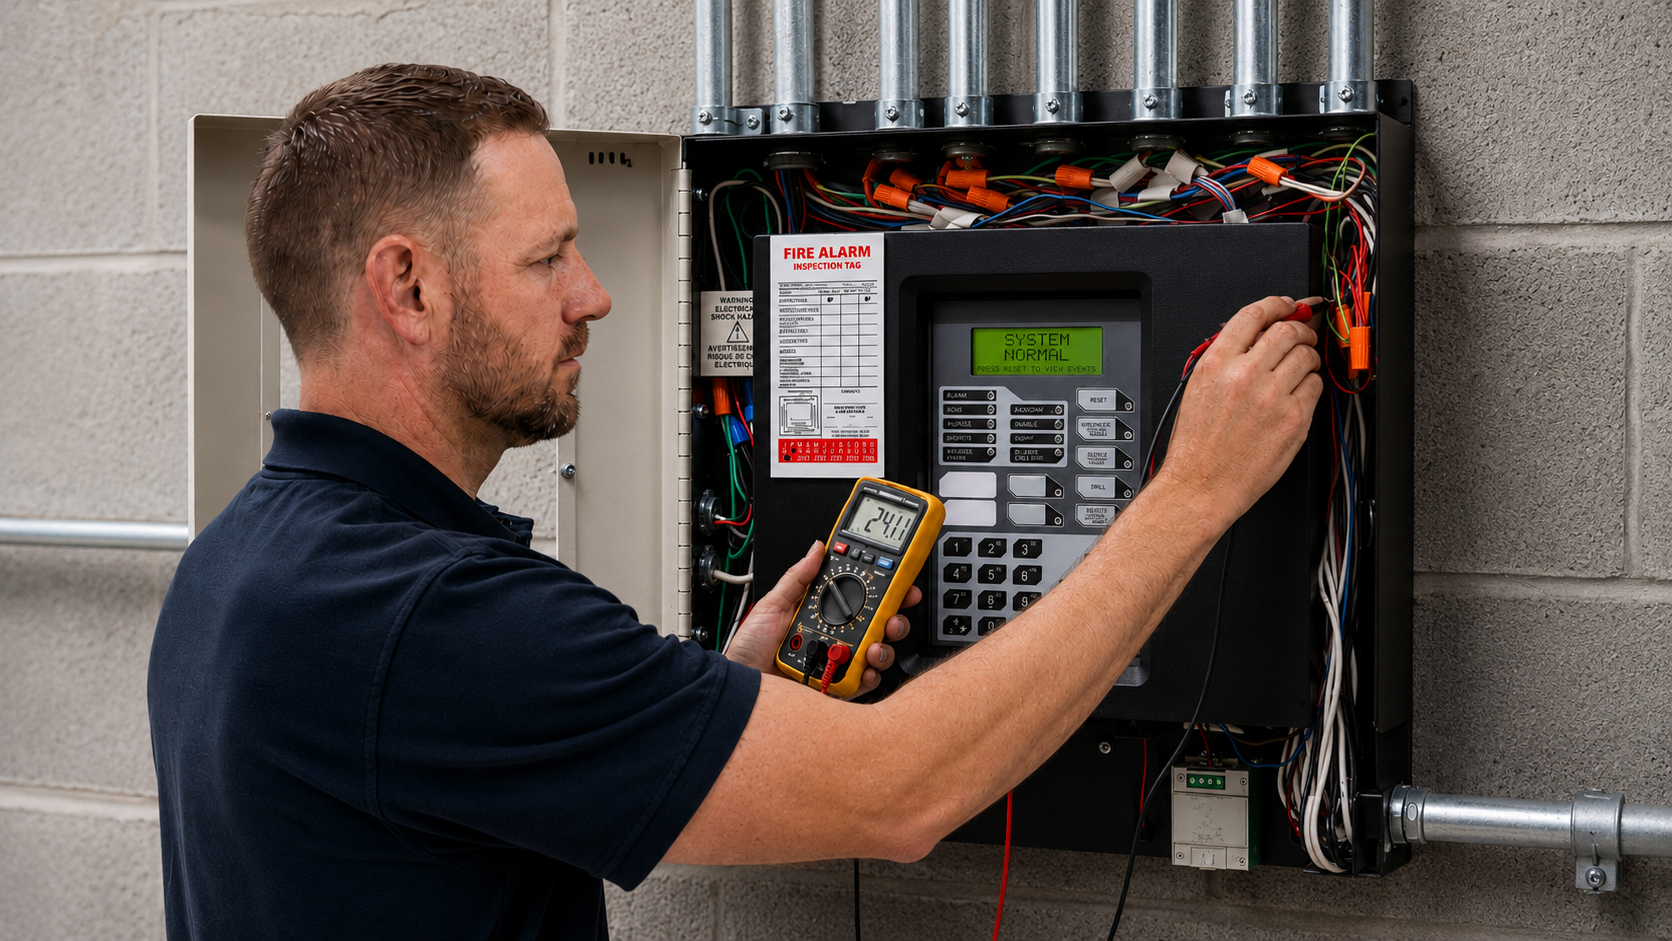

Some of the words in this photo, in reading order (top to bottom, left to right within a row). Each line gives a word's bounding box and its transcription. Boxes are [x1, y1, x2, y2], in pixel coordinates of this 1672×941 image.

[783, 247, 815, 260] FIRE
[818, 245, 871, 259] ALARM
[793, 262, 843, 271] INSPECTION
[844, 261, 862, 270] TAG
[710, 313, 735, 321] SHOCK
[1004, 333, 1070, 346] SYSTEM
[1004, 348, 1069, 361] NORMAL
[954, 542, 959, 552] 1
[988, 543, 995, 554] 2
[1021, 543, 1028, 555] 3
[953, 568, 960, 579] 4
[988, 569, 995, 580] 5
[1021, 570, 1028, 581] 6
[953, 593, 960, 605] 7
[987, 595, 995, 605] 8
[1021, 596, 1028, 607] 9
